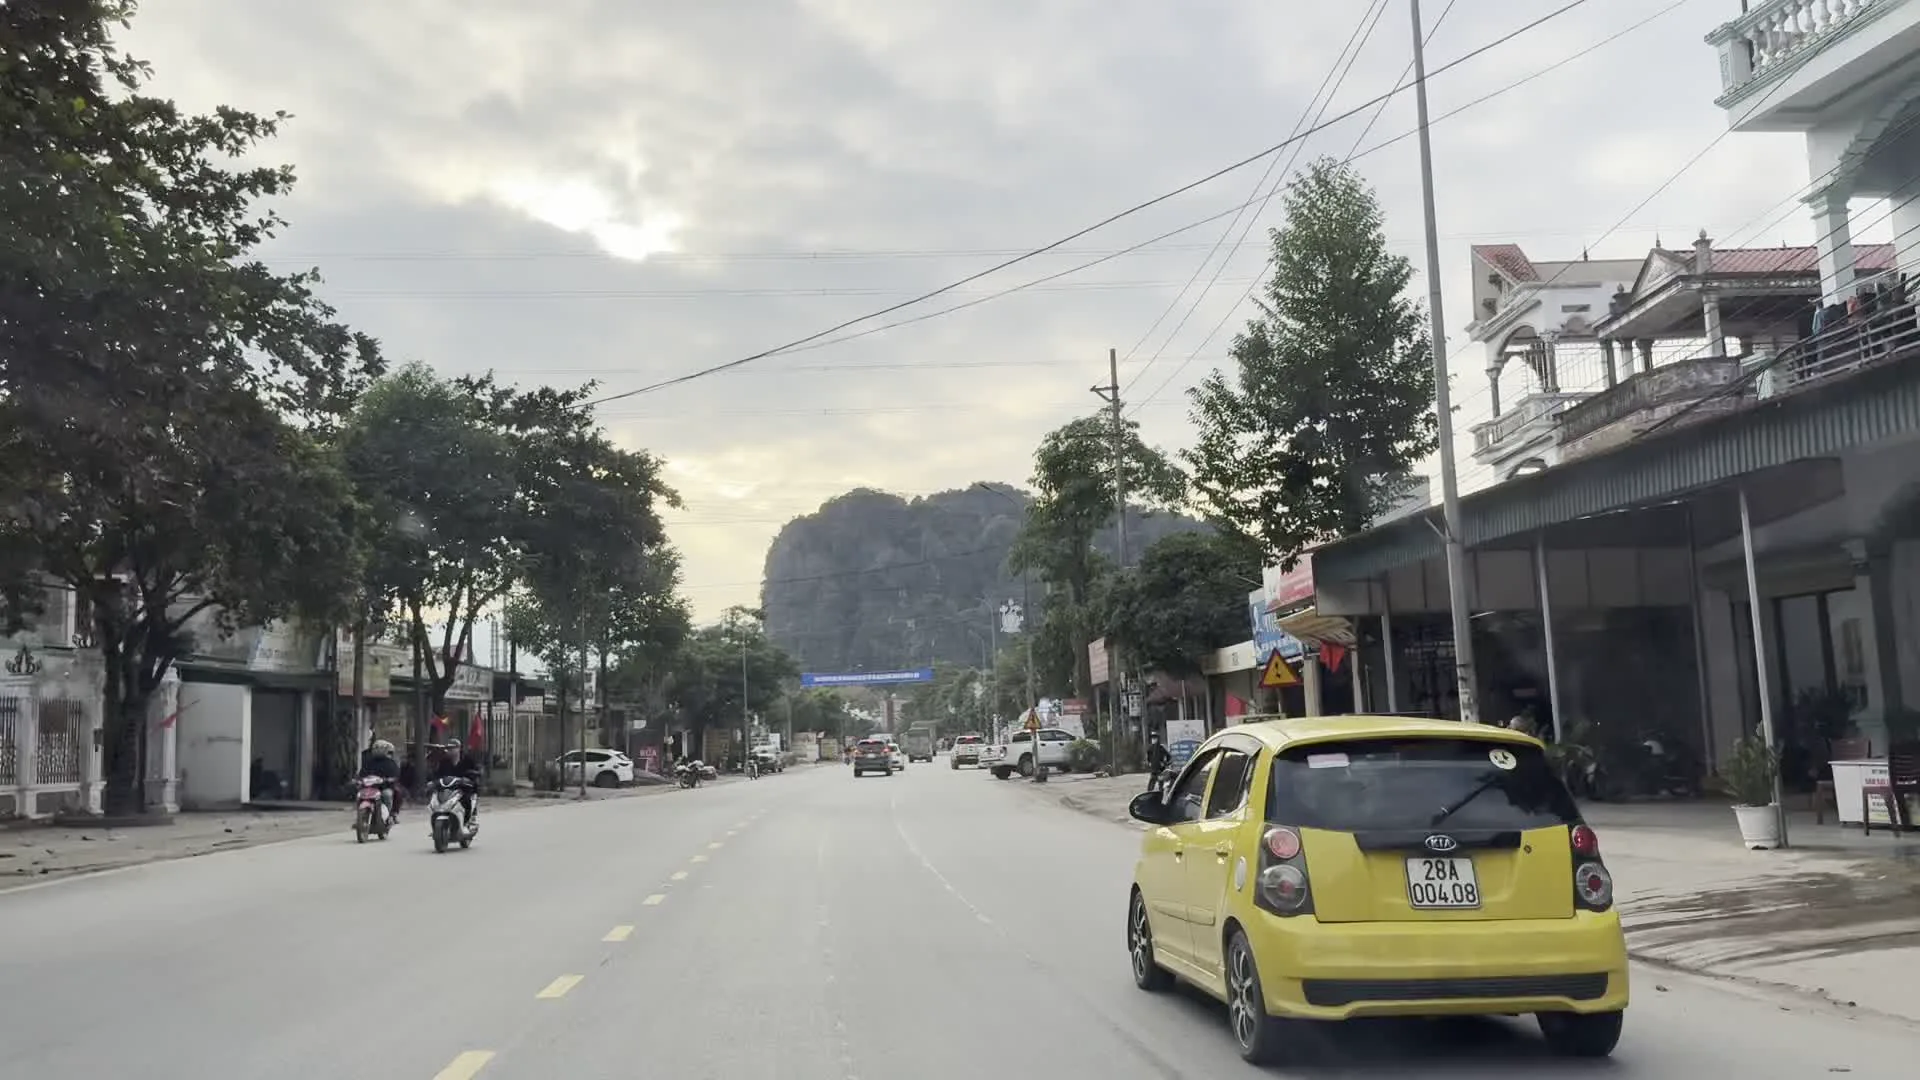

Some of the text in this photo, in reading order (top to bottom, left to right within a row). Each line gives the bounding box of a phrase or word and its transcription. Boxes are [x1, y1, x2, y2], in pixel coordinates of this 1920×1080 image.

[1430, 838, 1452, 849] KIA
[1423, 859, 1459, 881] 28A
[1412, 883, 1477, 904] 004.08
